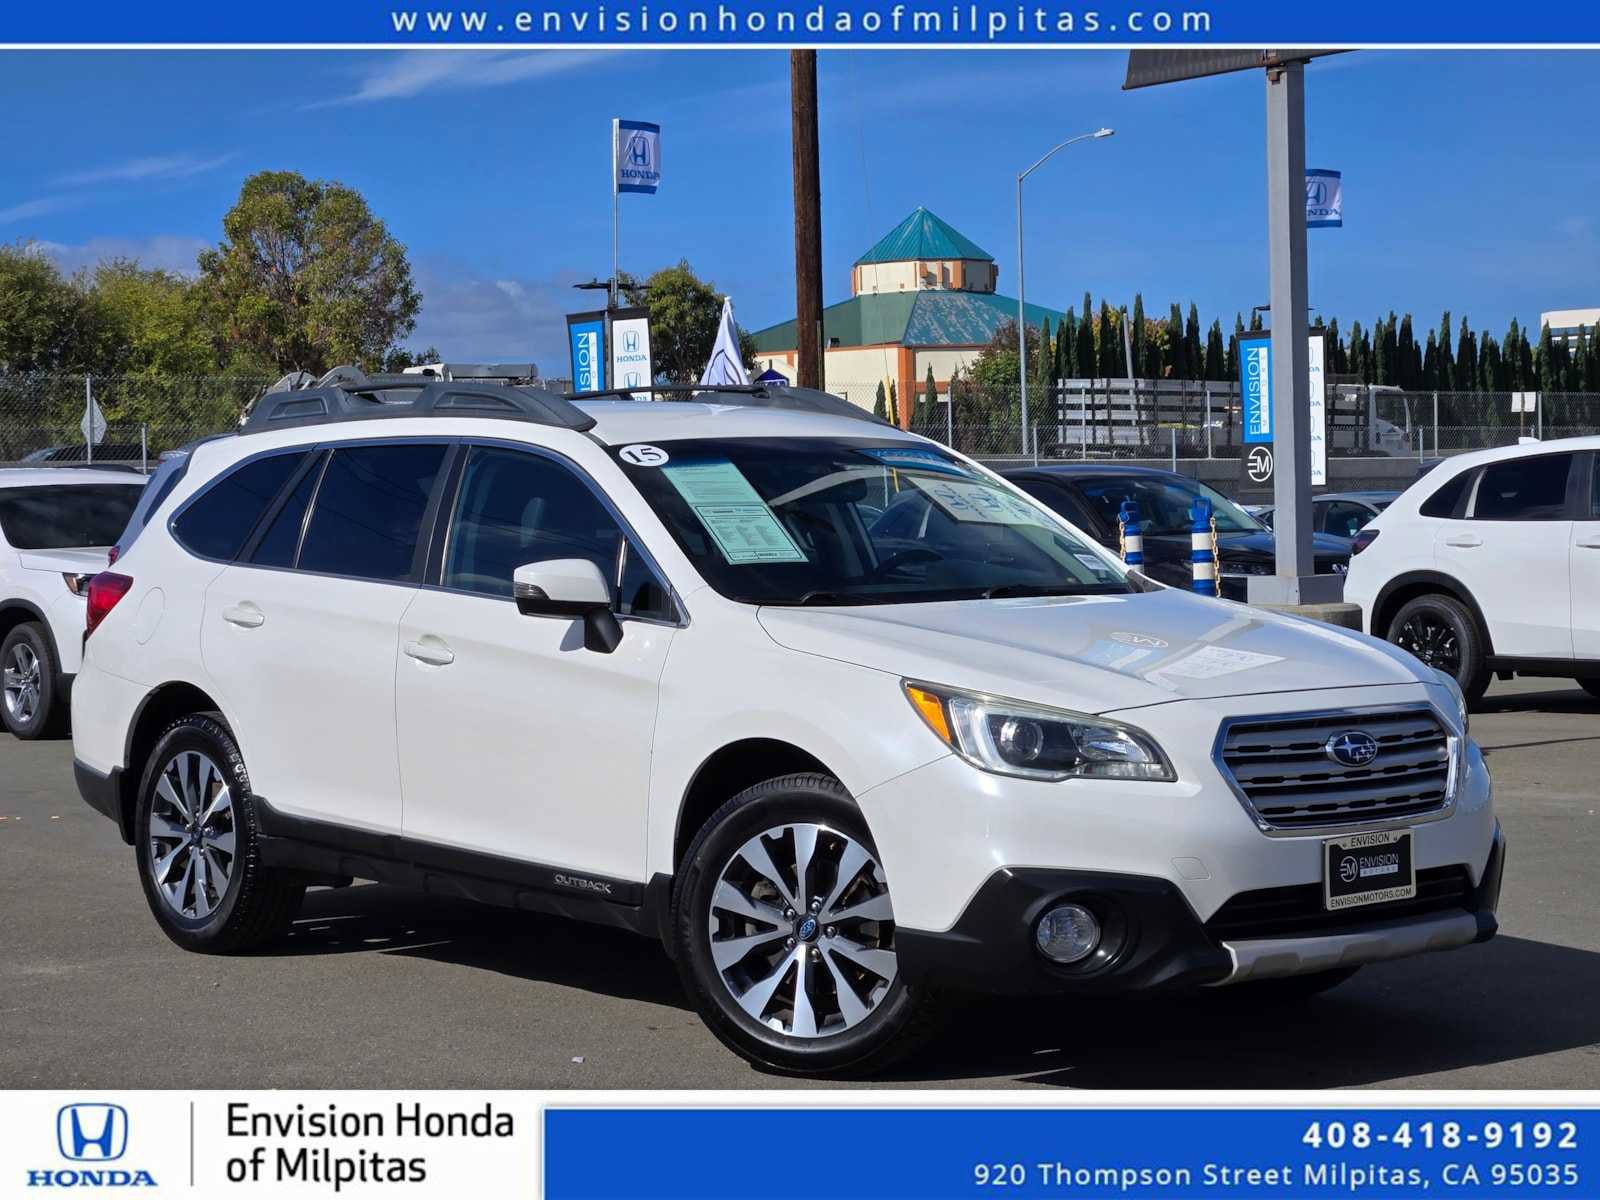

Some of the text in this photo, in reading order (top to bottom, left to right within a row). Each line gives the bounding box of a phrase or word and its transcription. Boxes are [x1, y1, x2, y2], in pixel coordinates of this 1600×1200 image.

[1307, 208, 1341, 216] NDA
[577, 332, 591, 391] ISION
[616, 354, 647, 363] HONDA
[1247, 347, 1261, 435] ENVISION
[1350, 833, 1390, 848] ENVISION
[1359, 853, 1399, 869] ENVISION
[554, 874, 612, 894] OUTBACK
[1330, 887, 1412, 908] ENVISIONMOTORS.COM
